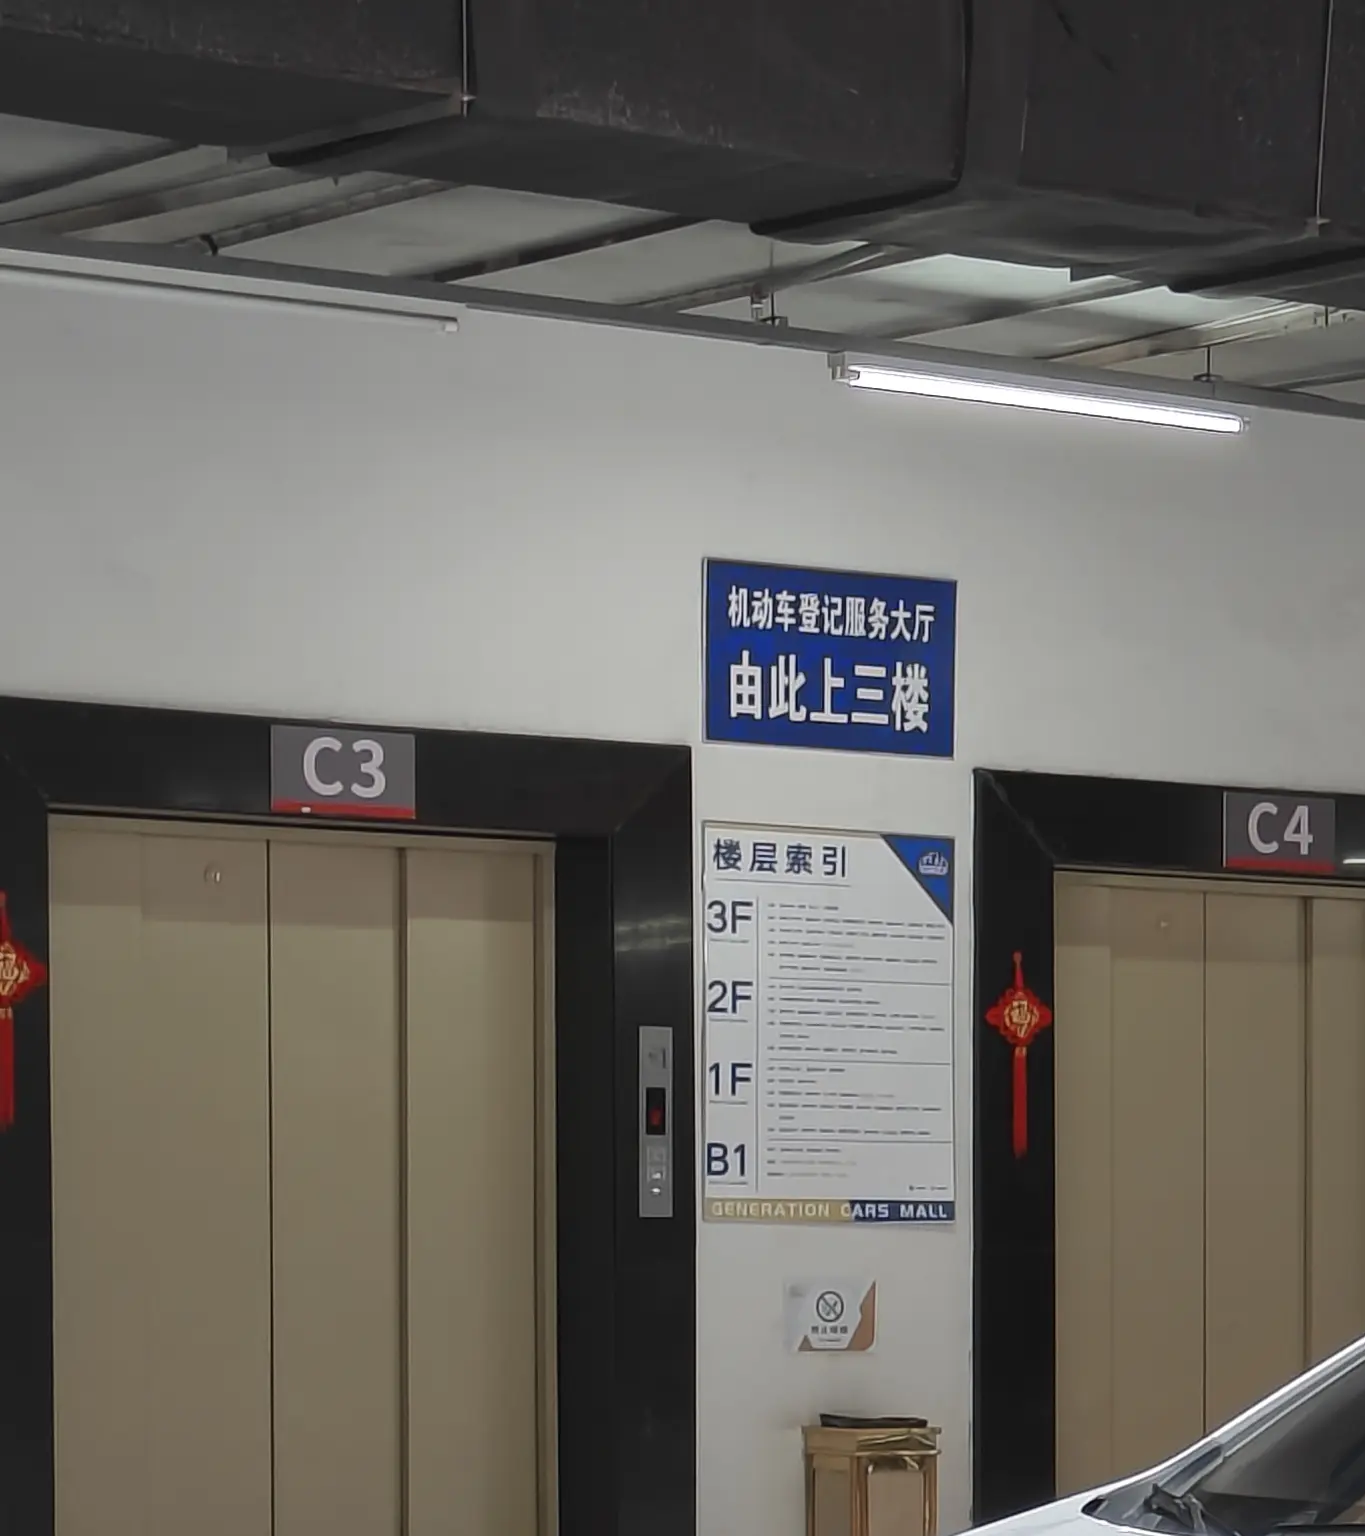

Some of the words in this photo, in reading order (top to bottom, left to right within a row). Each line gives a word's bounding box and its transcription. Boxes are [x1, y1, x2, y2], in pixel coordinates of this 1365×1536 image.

[728, 584, 935, 643] 机动车登记服务大厅
[728, 649, 930, 734] 由此上三楼
[303, 736, 387, 798] C3
[1247, 802, 1314, 855] C4
[713, 837, 846, 878] 楼层索引
[706, 900, 754, 934] 3F
[706, 980, 754, 1014] 2F
[708, 1062, 753, 1096] 1F
[706, 1142, 746, 1177] B1
[711, 1201, 830, 1218] GENERATION
[840, 1203, 890, 1218] CARS
[899, 1203, 948, 1219] MALL
